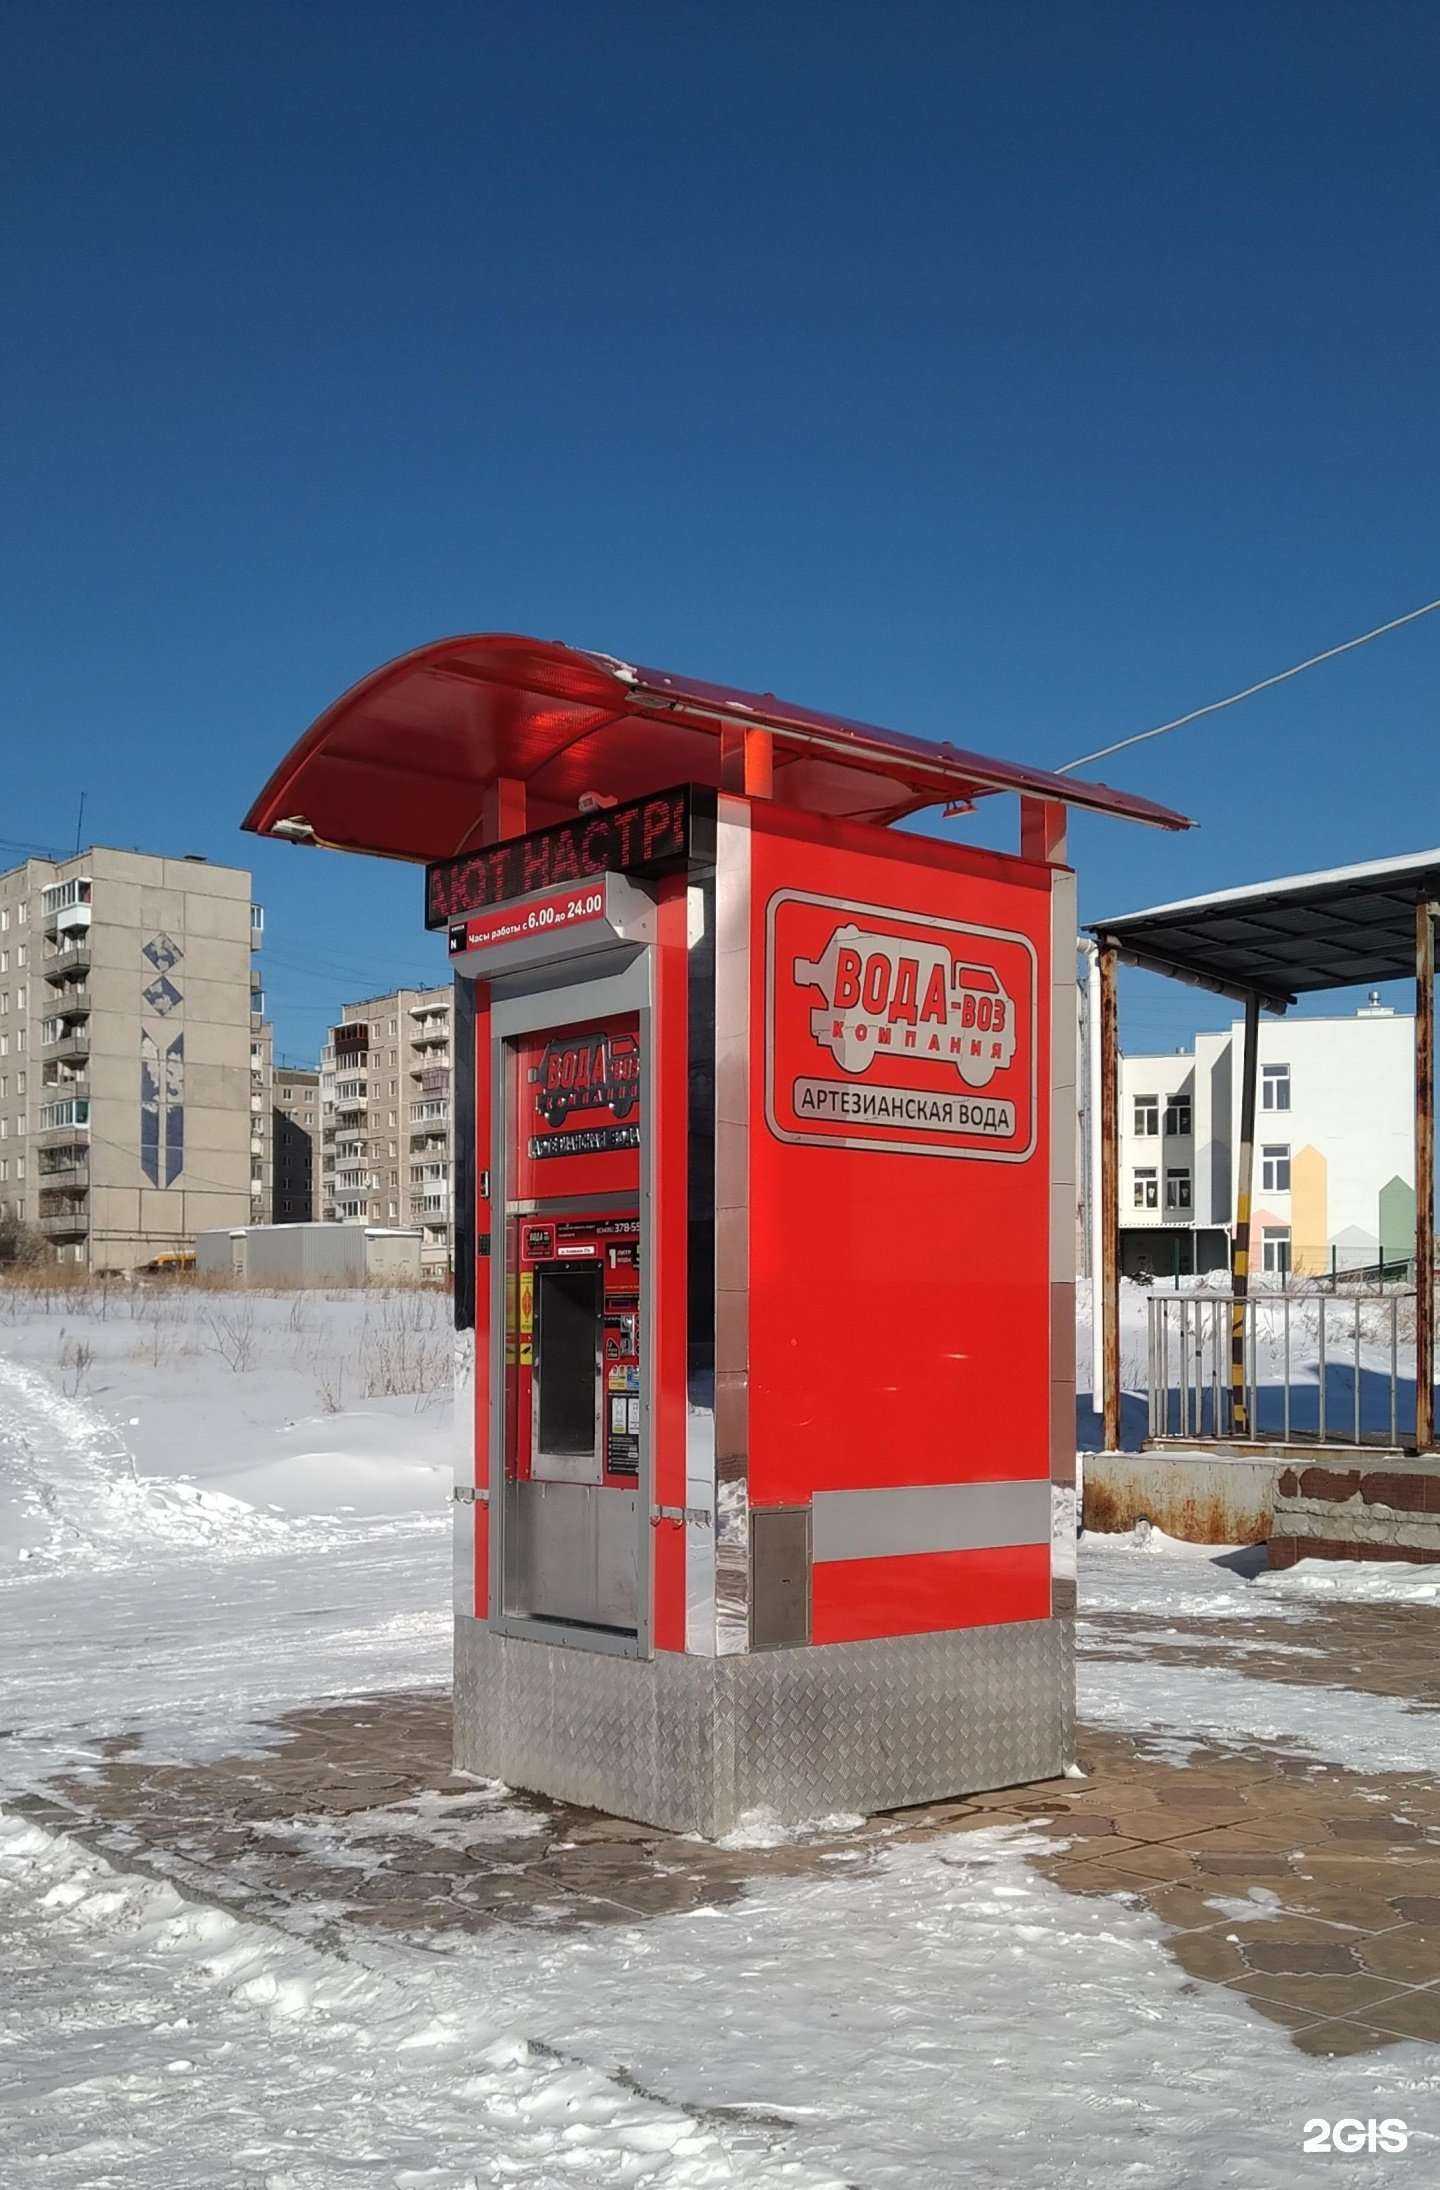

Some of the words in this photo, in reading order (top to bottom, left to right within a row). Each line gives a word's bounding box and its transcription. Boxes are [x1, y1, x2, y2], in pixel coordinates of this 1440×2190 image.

[468, 931, 490, 944] Часы
[491, 924, 521, 939] работы
[522, 922, 528, 931] с
[528, 907, 554, 928] 6.00
[555, 912, 566, 923] до
[567, 894, 602, 919] 24.00
[832, 1020, 1003, 1060] КОМПАНИЯ
[801, 1087, 953, 1124] АРТЕЗИАНСКАЯ
[958, 1104, 1010, 1132] ВОДА
